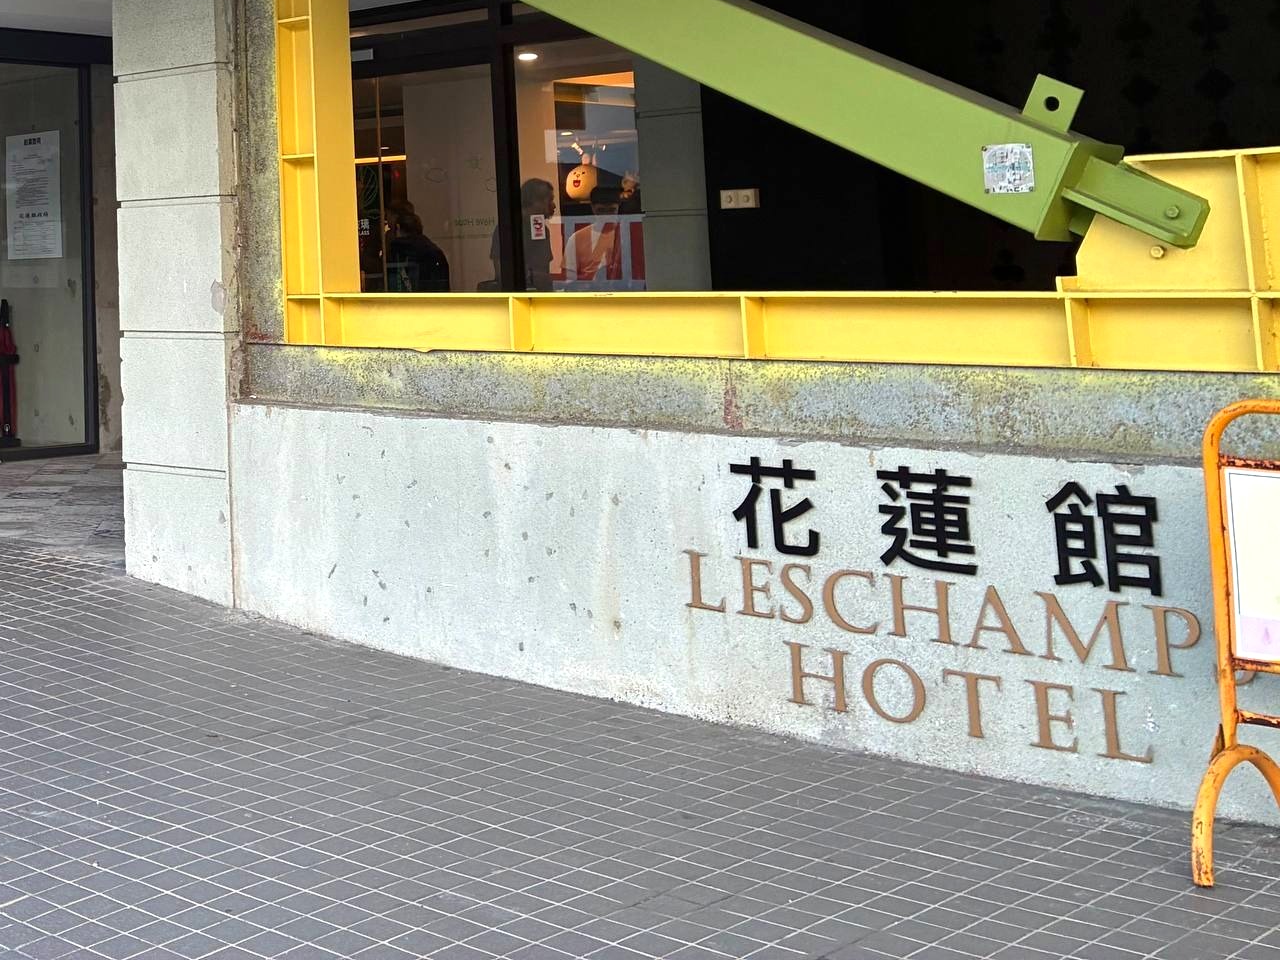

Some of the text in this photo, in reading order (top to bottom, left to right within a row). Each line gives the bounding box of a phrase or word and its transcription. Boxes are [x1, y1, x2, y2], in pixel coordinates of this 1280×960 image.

[729, 456, 1163, 597] 花蓮館
[782, 640, 1154, 764] HOTEL
